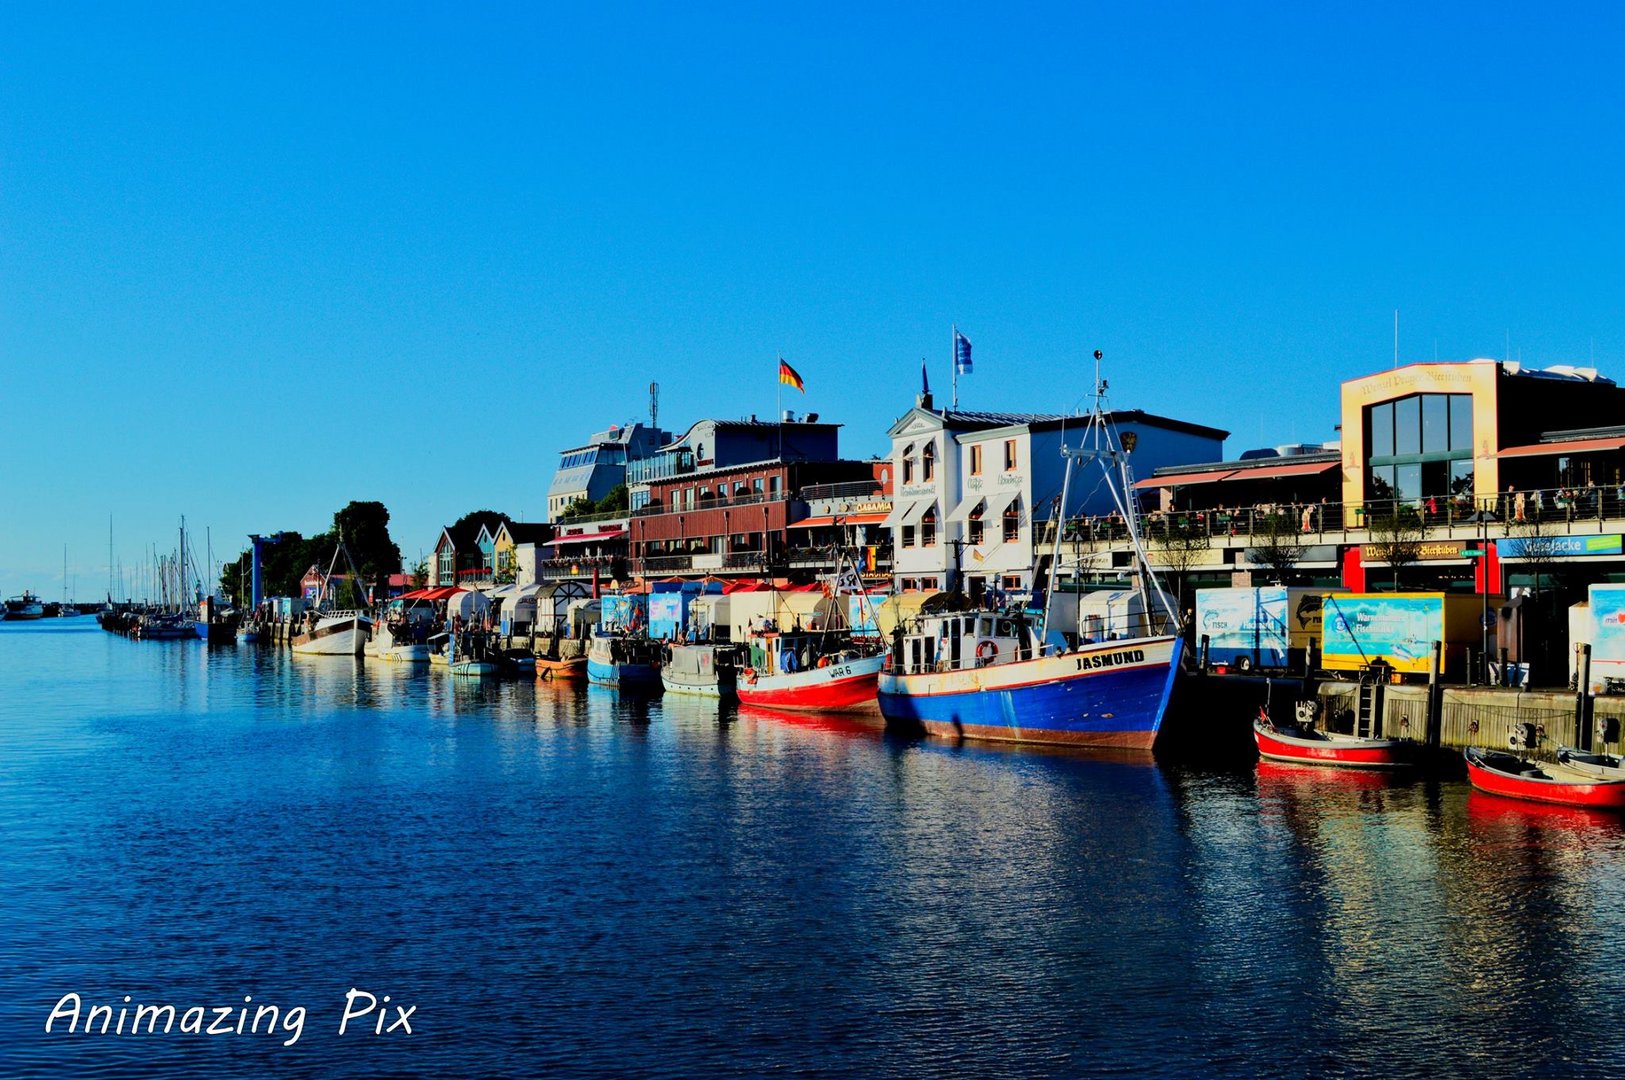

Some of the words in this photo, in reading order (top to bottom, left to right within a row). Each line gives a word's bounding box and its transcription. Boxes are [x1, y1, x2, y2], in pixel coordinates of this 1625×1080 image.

[1420, 545, 1458, 556] Bierstuben
[1076, 650, 1145, 670] JASMUND
[828, 667, 845, 678] WAR
[845, 665, 852, 675] 6
